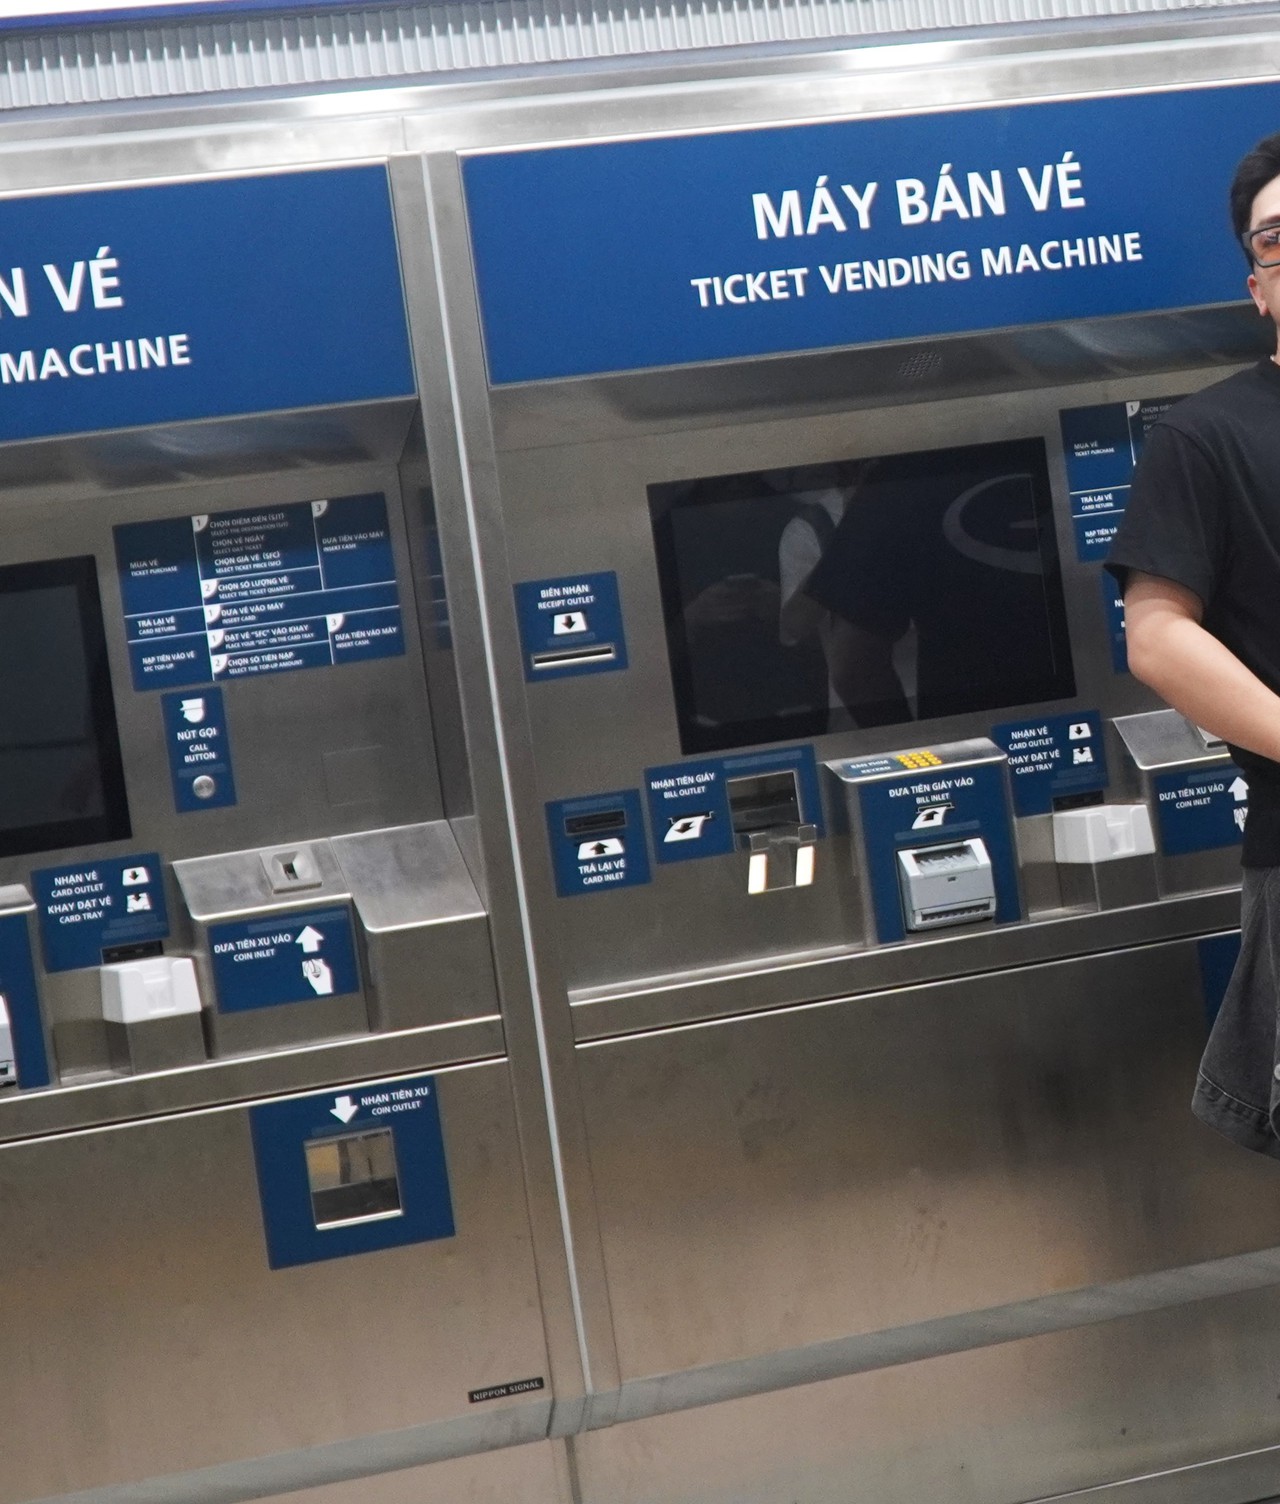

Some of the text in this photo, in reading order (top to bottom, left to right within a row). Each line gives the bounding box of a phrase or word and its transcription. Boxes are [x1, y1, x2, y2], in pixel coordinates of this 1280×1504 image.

[752, 147, 1085, 241] MÁY BÁN VÉ
[693, 230, 1142, 308] TICKET VENDING MACHINE
[53, 246, 122, 314] VÉ
[0, 334, 190, 384] MACHINE
[540, 586, 560, 598] BIÊN
[537, 595, 593, 609] RECEIPT OUTLET
[177, 727, 216, 741] NÚT GỌI
[1037, 725, 1047, 736] VÉ
[189, 744, 207, 753] CALL
[1008, 737, 1052, 750] CARD OUTLET
[184, 752, 215, 763] BUTTON
[1049, 748, 1059, 759] VÉ
[1015, 763, 1052, 775] CARD TRAY
[663, 786, 705, 799] BILL OUTLET
[888, 786, 909, 798] ĐƯA
[954, 775, 973, 788] VÀO
[1159, 791, 1176, 801] ĐƯA
[1196, 786, 1206, 795] XU
[1207, 783, 1224, 794] VÀO
[916, 793, 949, 805] BILL INLET
[1175, 797, 1210, 809] COIN INLET
[578, 858, 625, 875] TRẢ LẠI VÉ
[85, 870, 97, 882] VÉ
[583, 872, 623, 885] CARD INLET
[51, 884, 102, 897] CARD OUTLET
[47, 902, 74, 914] KHAY
[99, 895, 111, 908] VÉ
[59, 911, 102, 924] CARD TRAY
[214, 943, 234, 954] ĐƯA
[257, 937, 270, 948] XU
[272, 933, 291, 946] VÀO
[233, 949, 274, 962] COIN INLET
[414, 1087, 428, 1098] XU
[371, 1101, 420, 1116] COIN OUTLET
[473, 1381, 539, 1401] NIPPON SIGNAL
